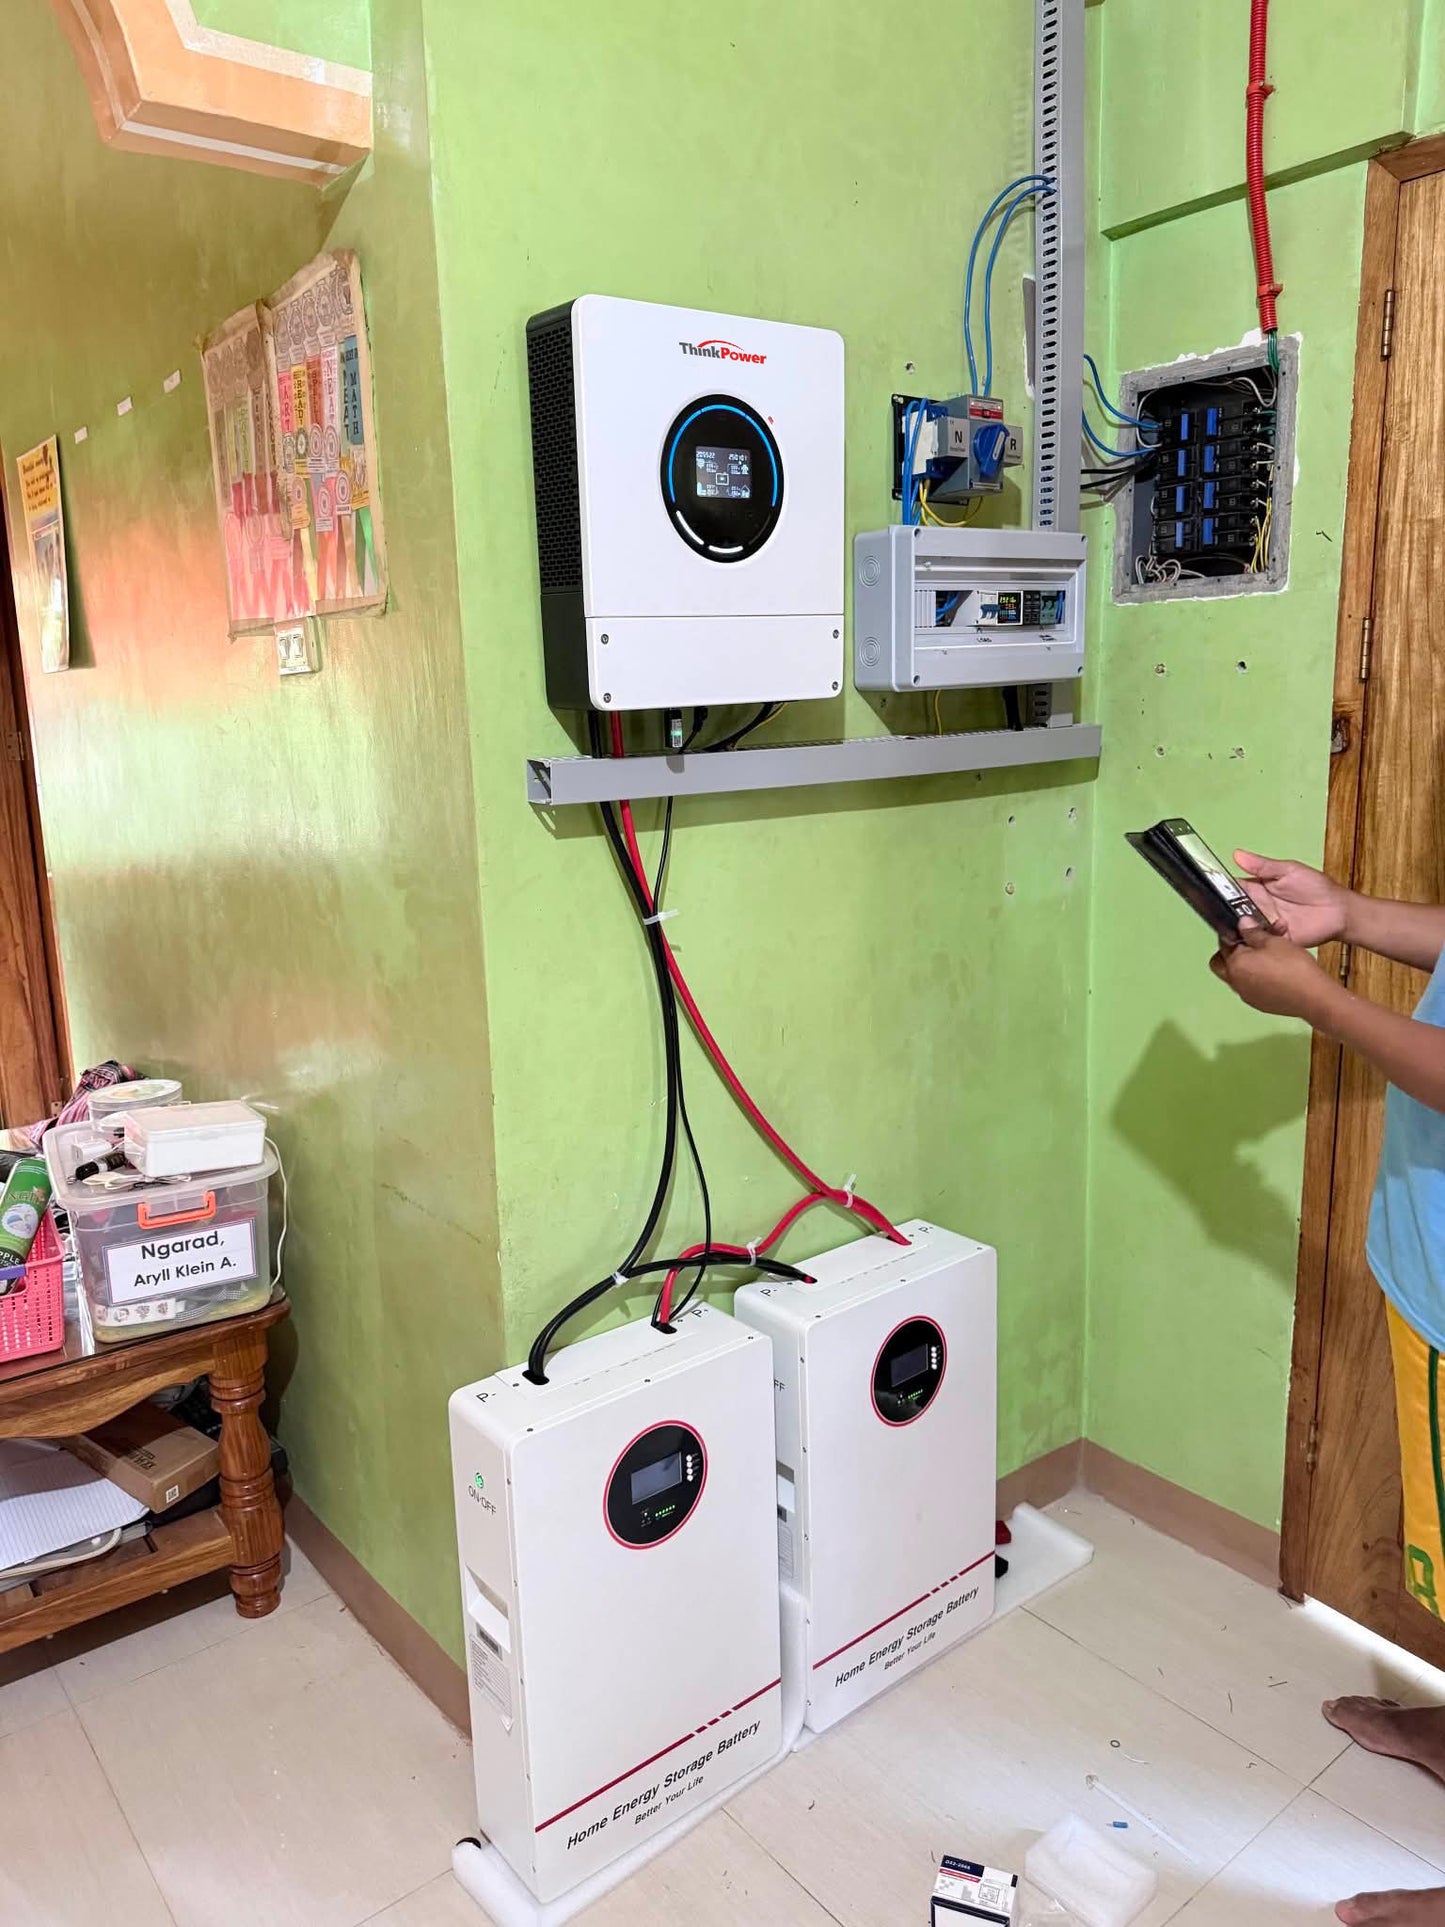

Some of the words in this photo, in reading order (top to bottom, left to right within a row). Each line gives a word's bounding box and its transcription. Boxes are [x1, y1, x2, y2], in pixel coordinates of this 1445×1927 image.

[679, 342, 767, 364] ThinkPower
[283, 384, 291, 431] ART
[350, 371, 360, 436] MATH
[954, 430, 963, 444] N
[1010, 437, 1018, 451] R
[141, 1230, 225, 1260] Ngarad,
[134, 1268, 170, 1287] Aryll
[175, 1260, 215, 1279] Klein
[220, 1257, 237, 1270] A.
[835, 1661, 866, 1688] Home
[868, 1634, 905, 1665] Energy
[906, 1609, 944, 1641] Storage
[946, 1586, 980, 1614] Battery
[884, 1652, 906, 1670] Better
[907, 1641, 922, 1656] Your
[923, 1631, 936, 1645] Life
[566, 1816, 608, 1850] Home
[612, 1784, 660, 1821] Energy
[664, 1750, 714, 1789] Storage
[717, 1720, 761, 1755] Battery
[634, 1801, 663, 1826] Better
[665, 1787, 686, 1806] Your
[687, 1775, 704, 1791] Life
